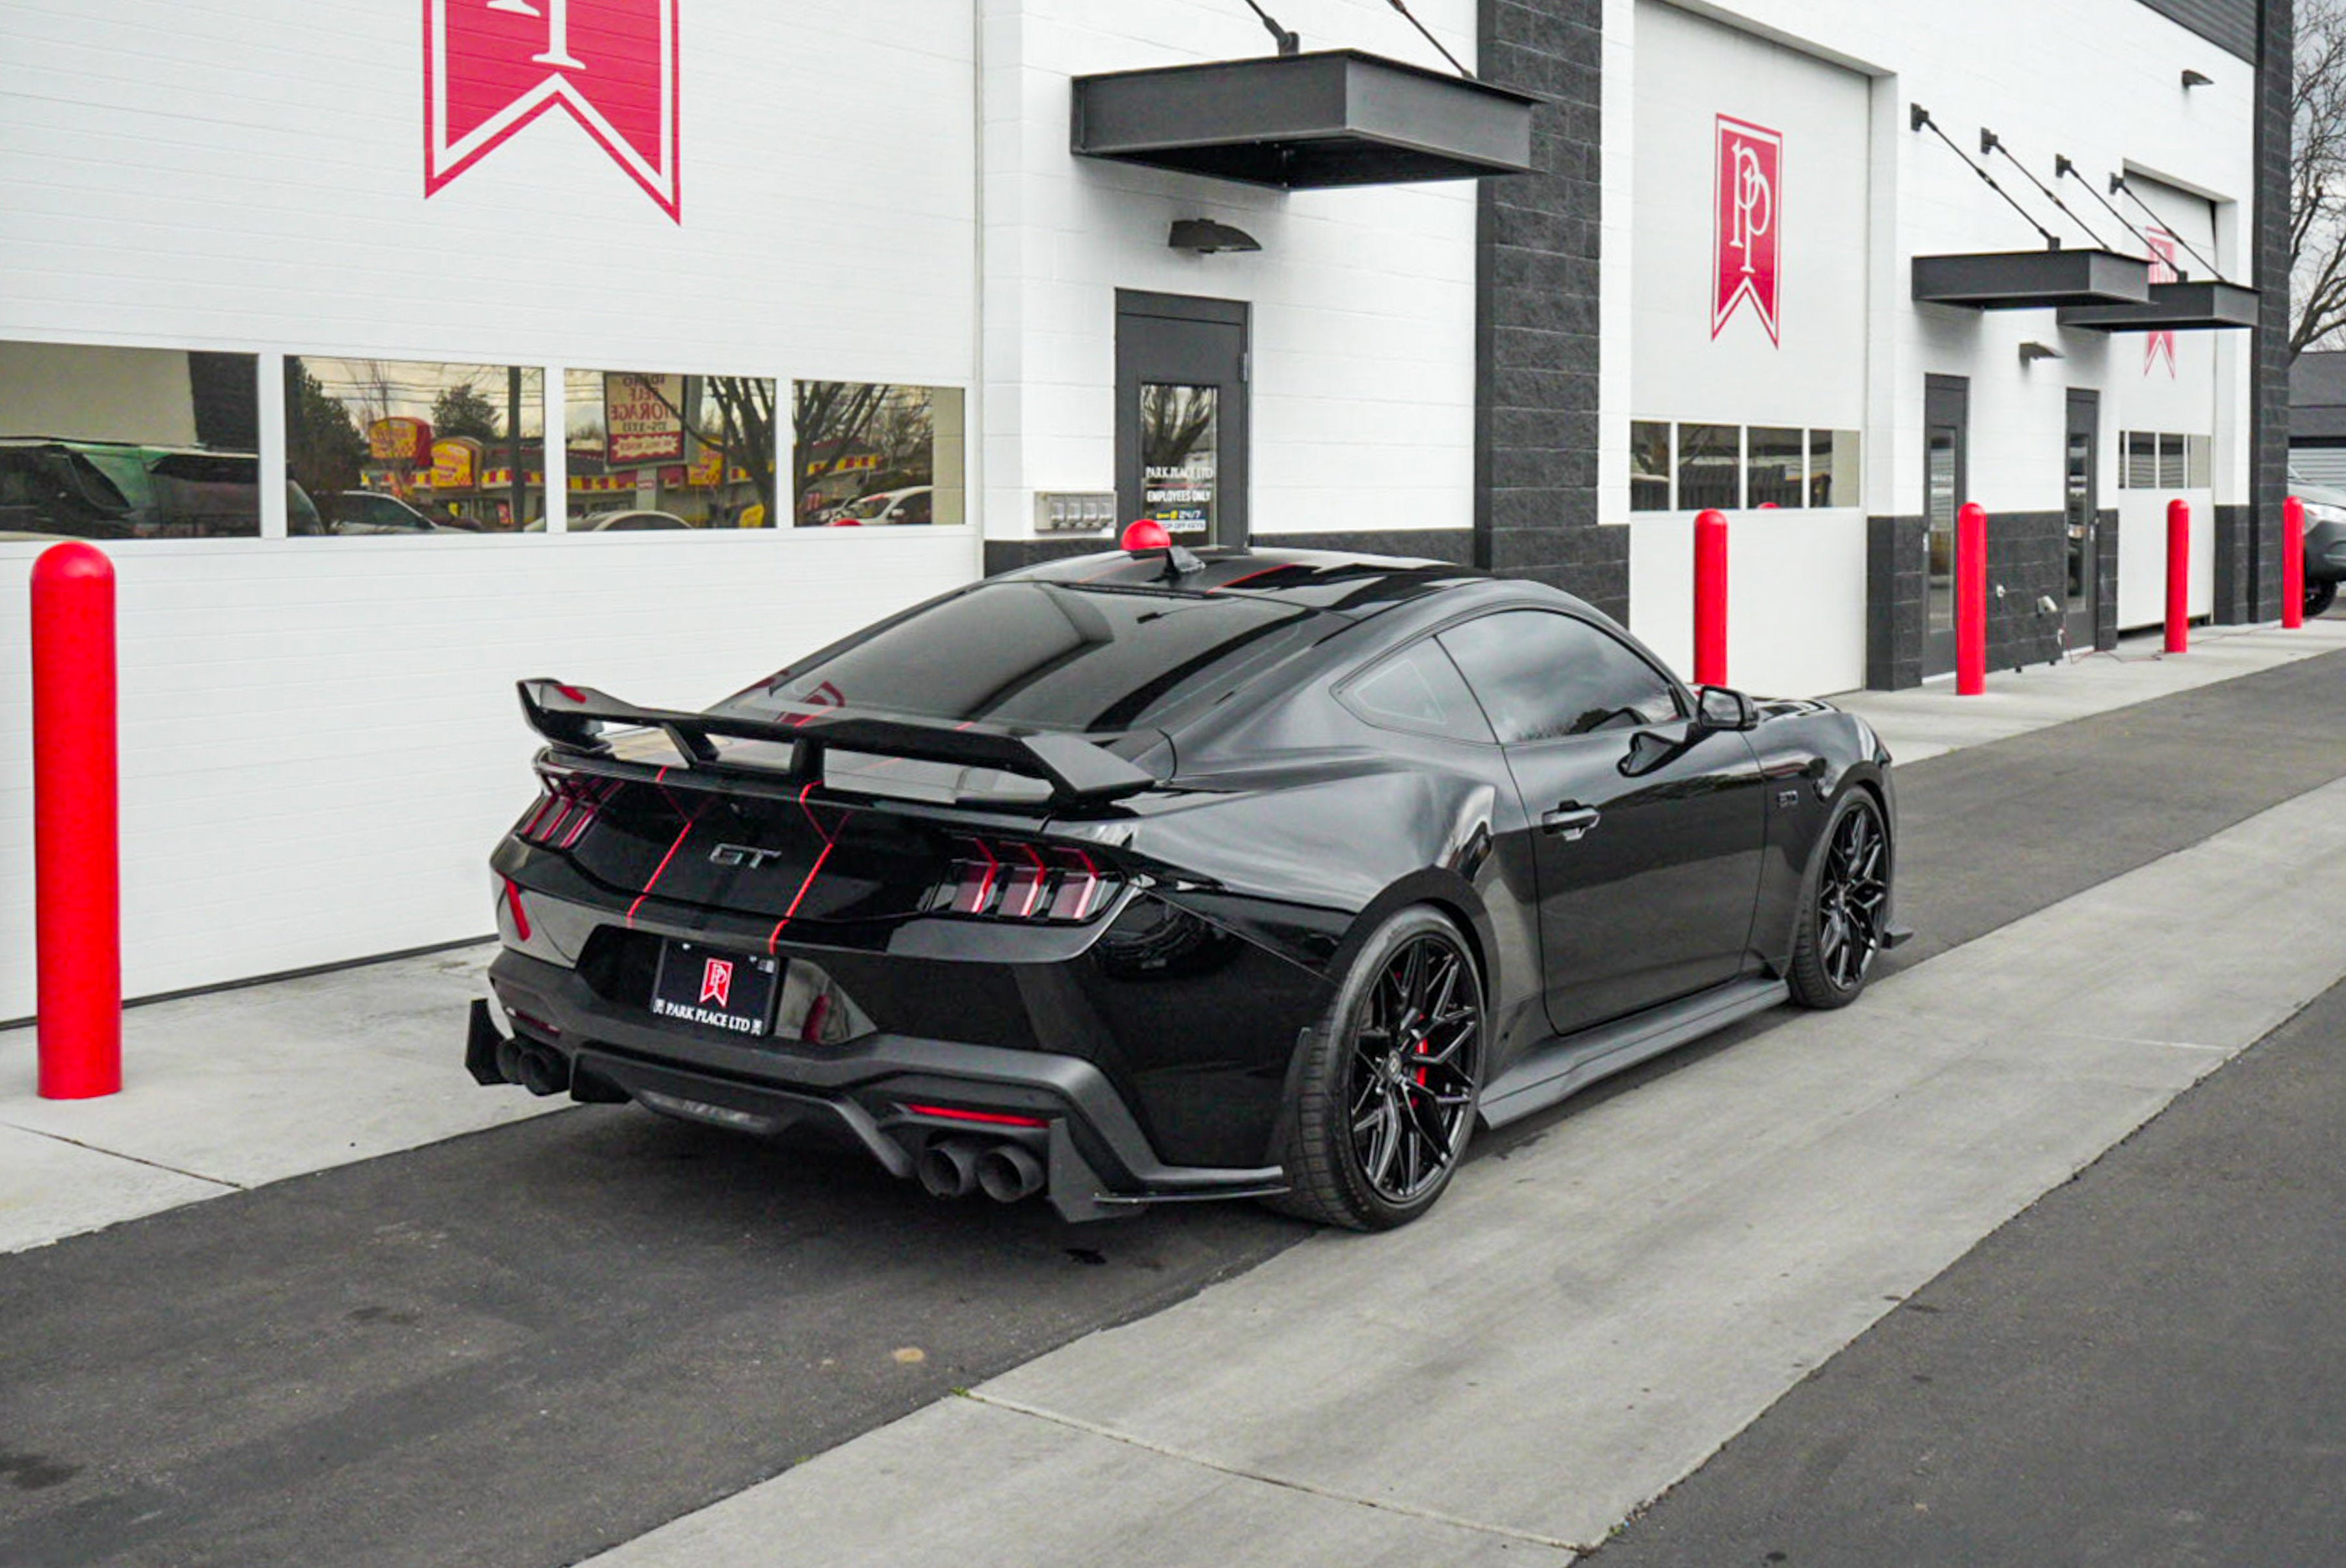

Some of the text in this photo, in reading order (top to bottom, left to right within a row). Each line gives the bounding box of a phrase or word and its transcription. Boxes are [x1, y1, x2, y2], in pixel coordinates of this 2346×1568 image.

[1145, 466, 1213, 480] PARK PLACE LTD
[1146, 489, 1211, 502] EMPLOYEES ONLY
[1178, 510, 1202, 519] 24/7
[710, 843, 783, 869] GT
[665, 1002, 750, 1032] PARK PLACE LTD
